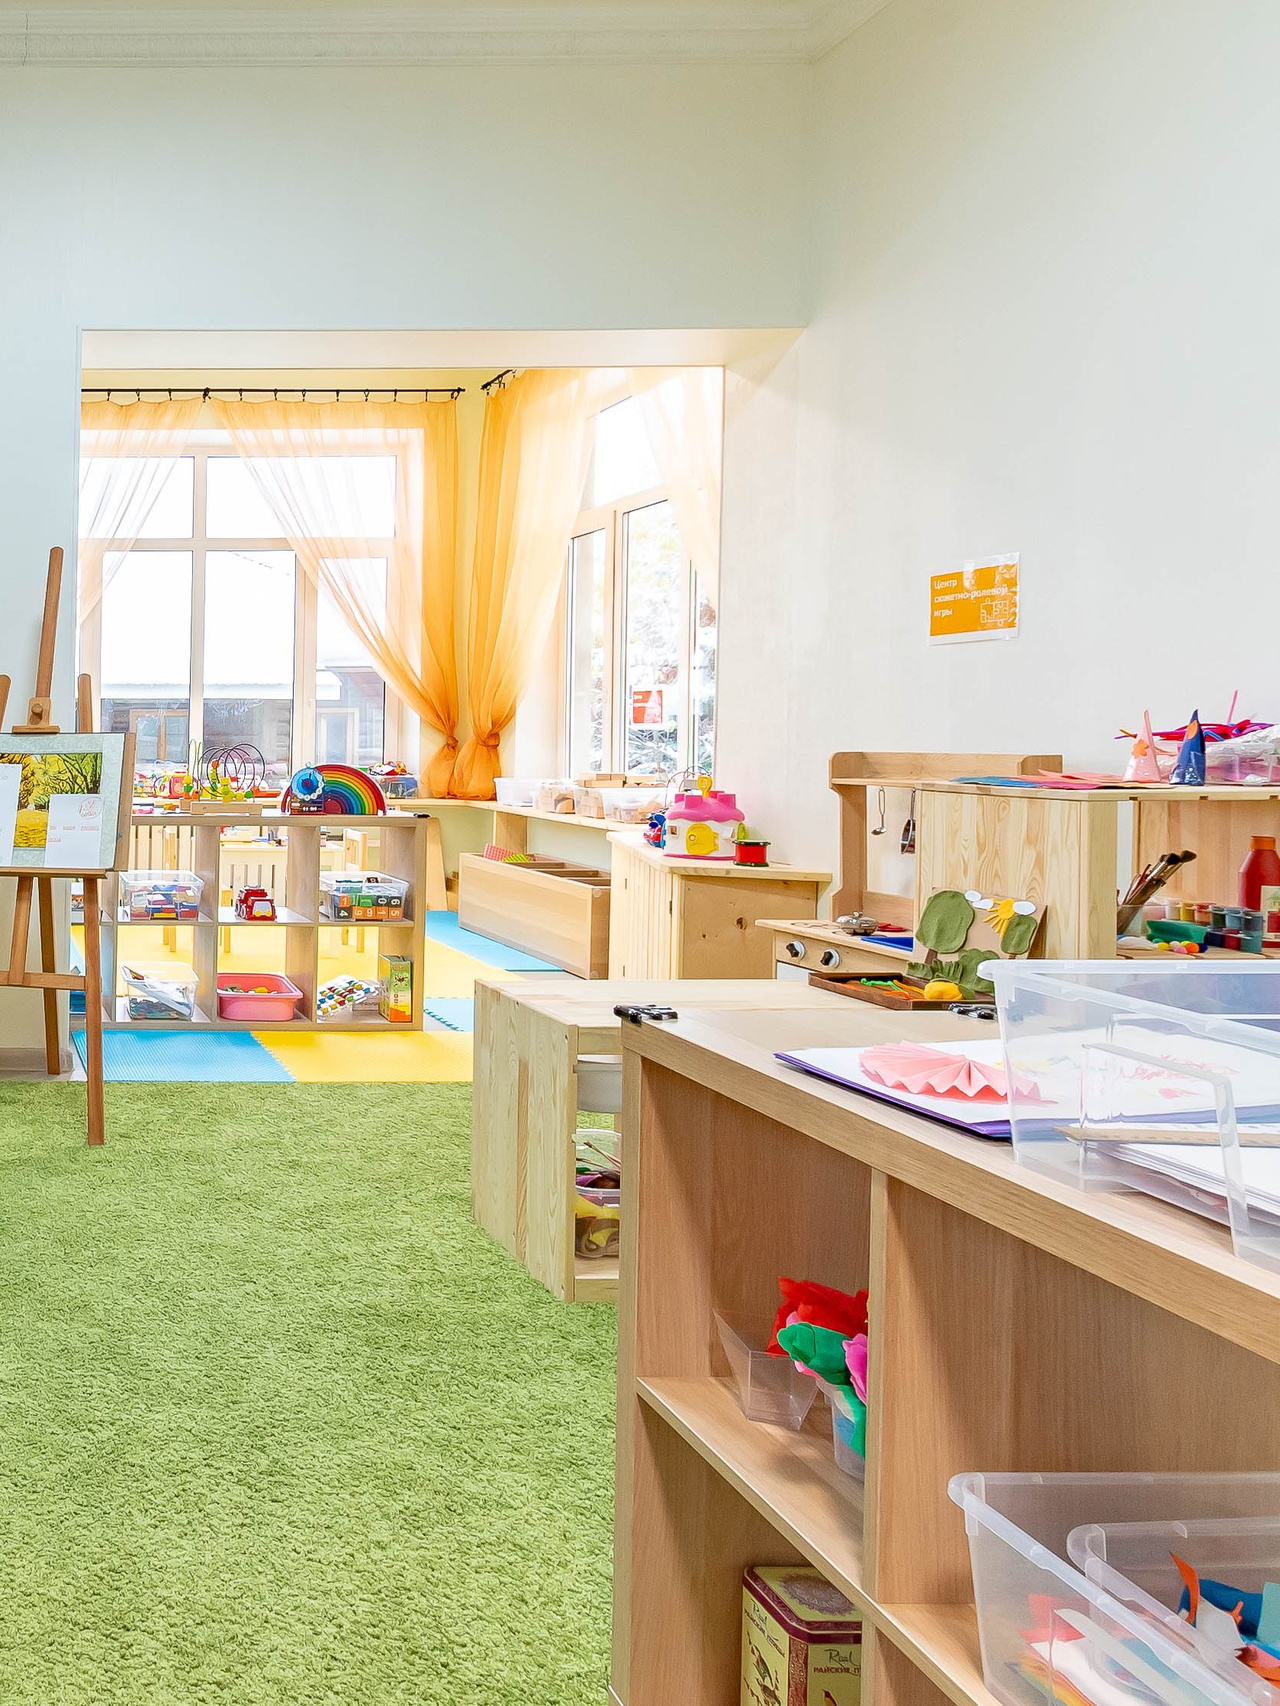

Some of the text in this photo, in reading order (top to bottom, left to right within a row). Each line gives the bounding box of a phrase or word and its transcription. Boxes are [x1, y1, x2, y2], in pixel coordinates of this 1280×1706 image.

[934, 579, 958, 590] Центр
[934, 584, 1008, 603] сюжетно-ролевой
[933, 608, 953, 618] игры
[824, 1648, 861, 1667] Real
[813, 1665, 850, 1673] РАЙСКИЕ
